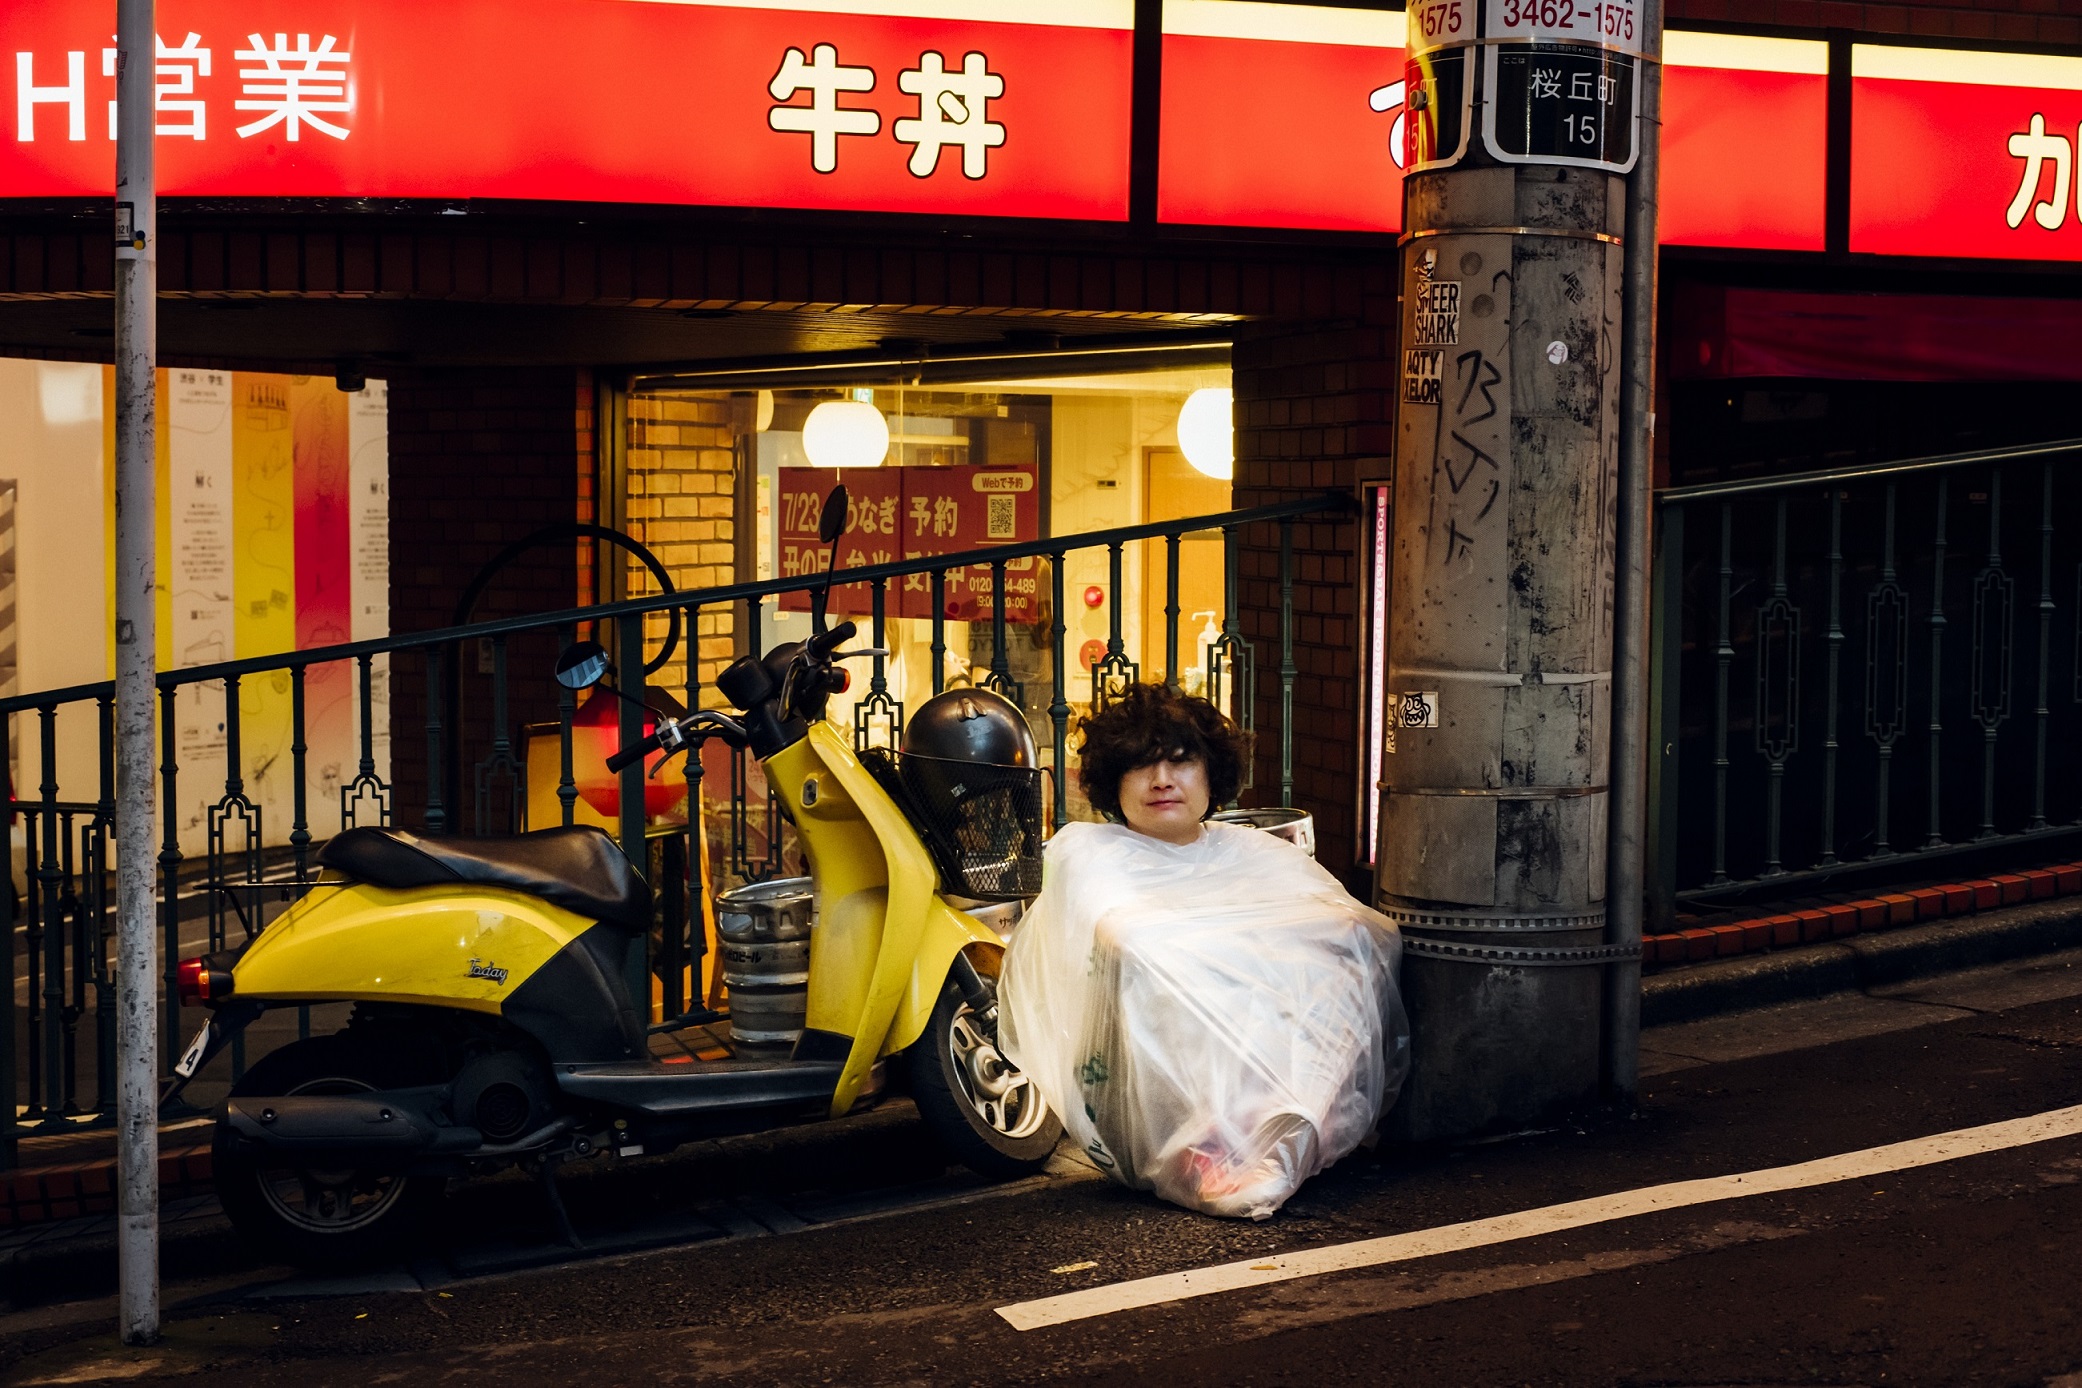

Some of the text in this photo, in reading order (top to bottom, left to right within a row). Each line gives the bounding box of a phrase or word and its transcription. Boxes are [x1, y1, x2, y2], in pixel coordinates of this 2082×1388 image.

[1419, 2, 1461, 37] 1575
[1503, 0, 1633, 40] 3462-1575
[1531, 68, 1616, 106] 桜丘町
[768, 42, 1007, 181] 牛丼
[1564, 113, 1596, 144] 15
[1414, 314, 1457, 343] SHARK
[1406, 351, 1440, 375] AQTY
[1403, 378, 1441, 402] XELOR
[982, 476, 1023, 489] Webで予約
[783, 492, 819, 532] 7/23
[909, 496, 958, 537] 予約
[969, 576, 1035, 594] 01204-489
[468, 957, 509, 986] Today
[186, 1048, 199, 1071] 4
